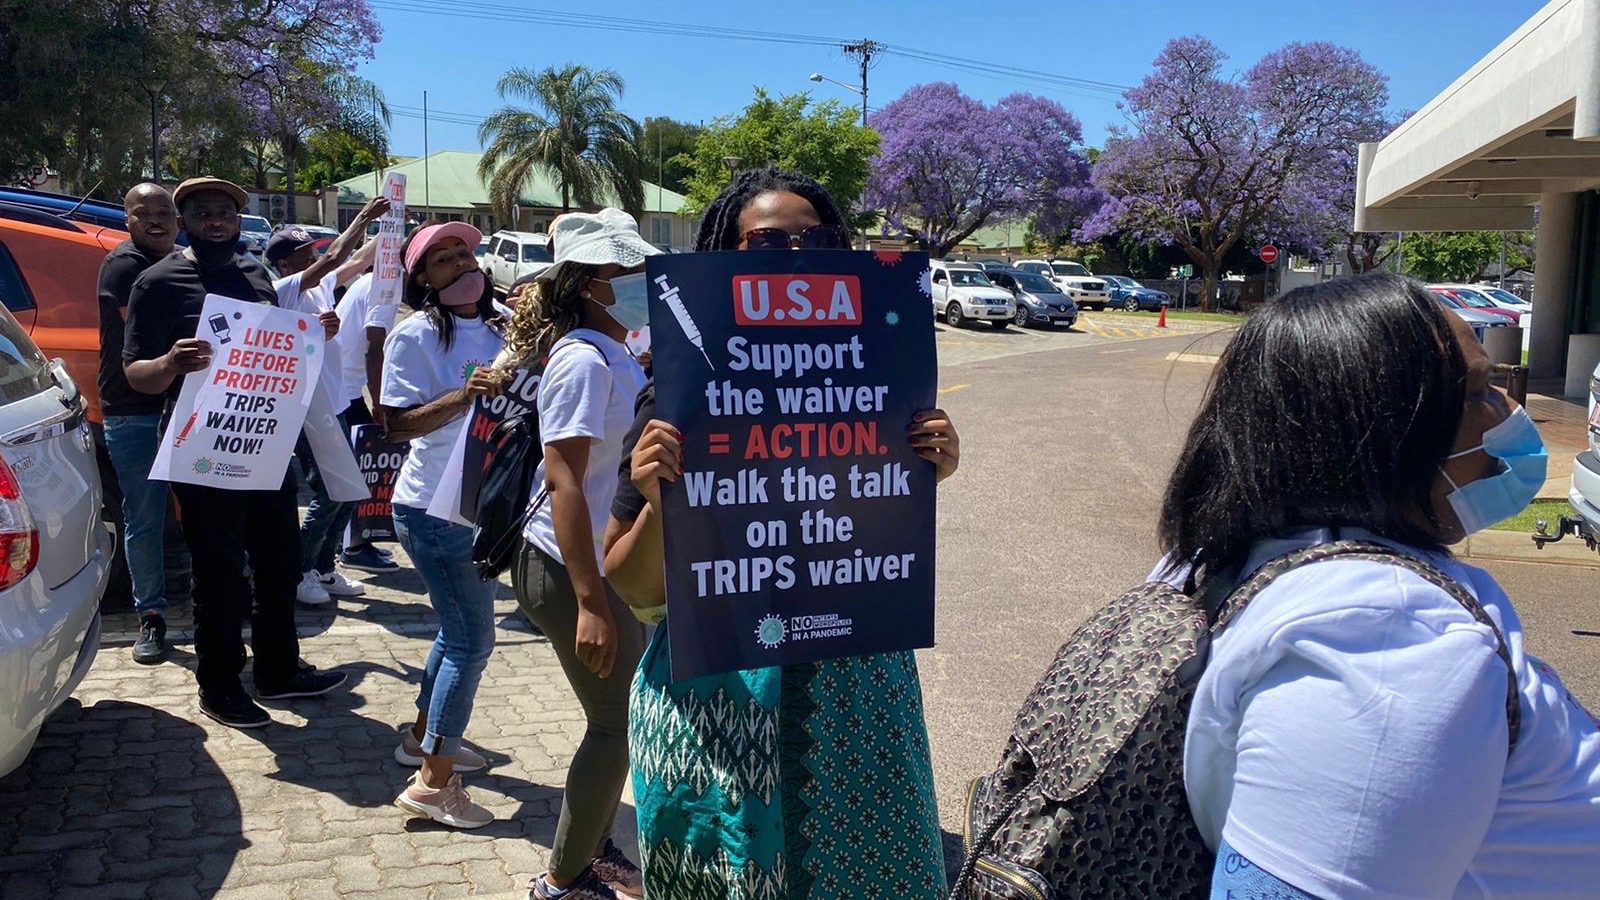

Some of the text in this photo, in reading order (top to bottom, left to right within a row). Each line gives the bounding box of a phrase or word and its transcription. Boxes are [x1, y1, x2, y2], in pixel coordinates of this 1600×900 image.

[381, 220, 396, 234] TRIPS
[740, 280, 857, 321] U.S.A
[243, 327, 295, 351] LIVES
[227, 348, 299, 373] BEFORE
[727, 334, 864, 378] Support
[213, 369, 298, 395] PROFITS!
[224, 392, 276, 414] TRIPS
[705, 378, 889, 416] the waiver
[206, 411, 278, 435] WAIVER
[213, 435, 264, 455] NOW!
[744, 422, 889, 460] ACTION.
[684, 463, 911, 507] Walk the talk
[746, 509, 854, 548] on the
[691, 548, 915, 598] TRIPS waiver
[792, 617, 813, 631] NO
[792, 628, 852, 641] IN A PANDEMIC
